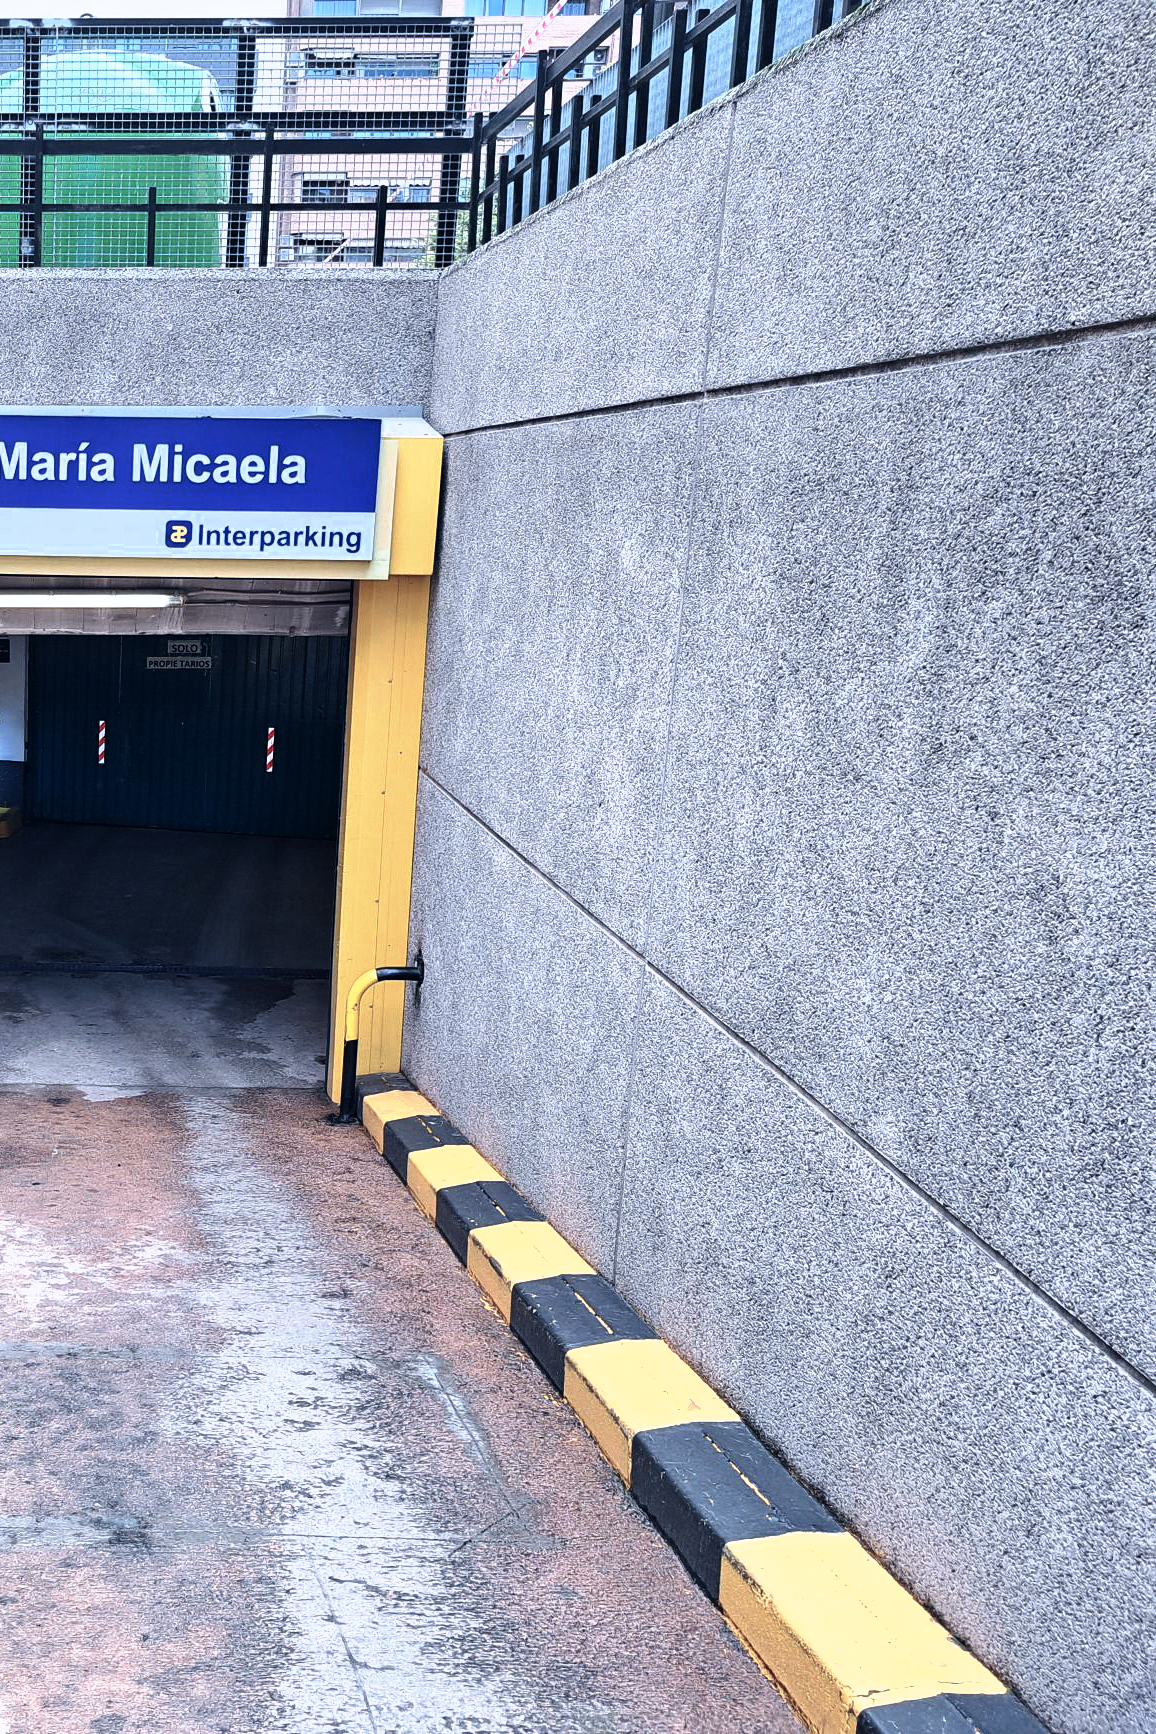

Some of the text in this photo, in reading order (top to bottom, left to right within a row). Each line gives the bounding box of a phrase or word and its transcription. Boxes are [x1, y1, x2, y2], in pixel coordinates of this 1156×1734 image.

[132, 444, 306, 485] Micaela
[198, 524, 362, 554] Interparking
[171, 643, 199, 653] SOLO
